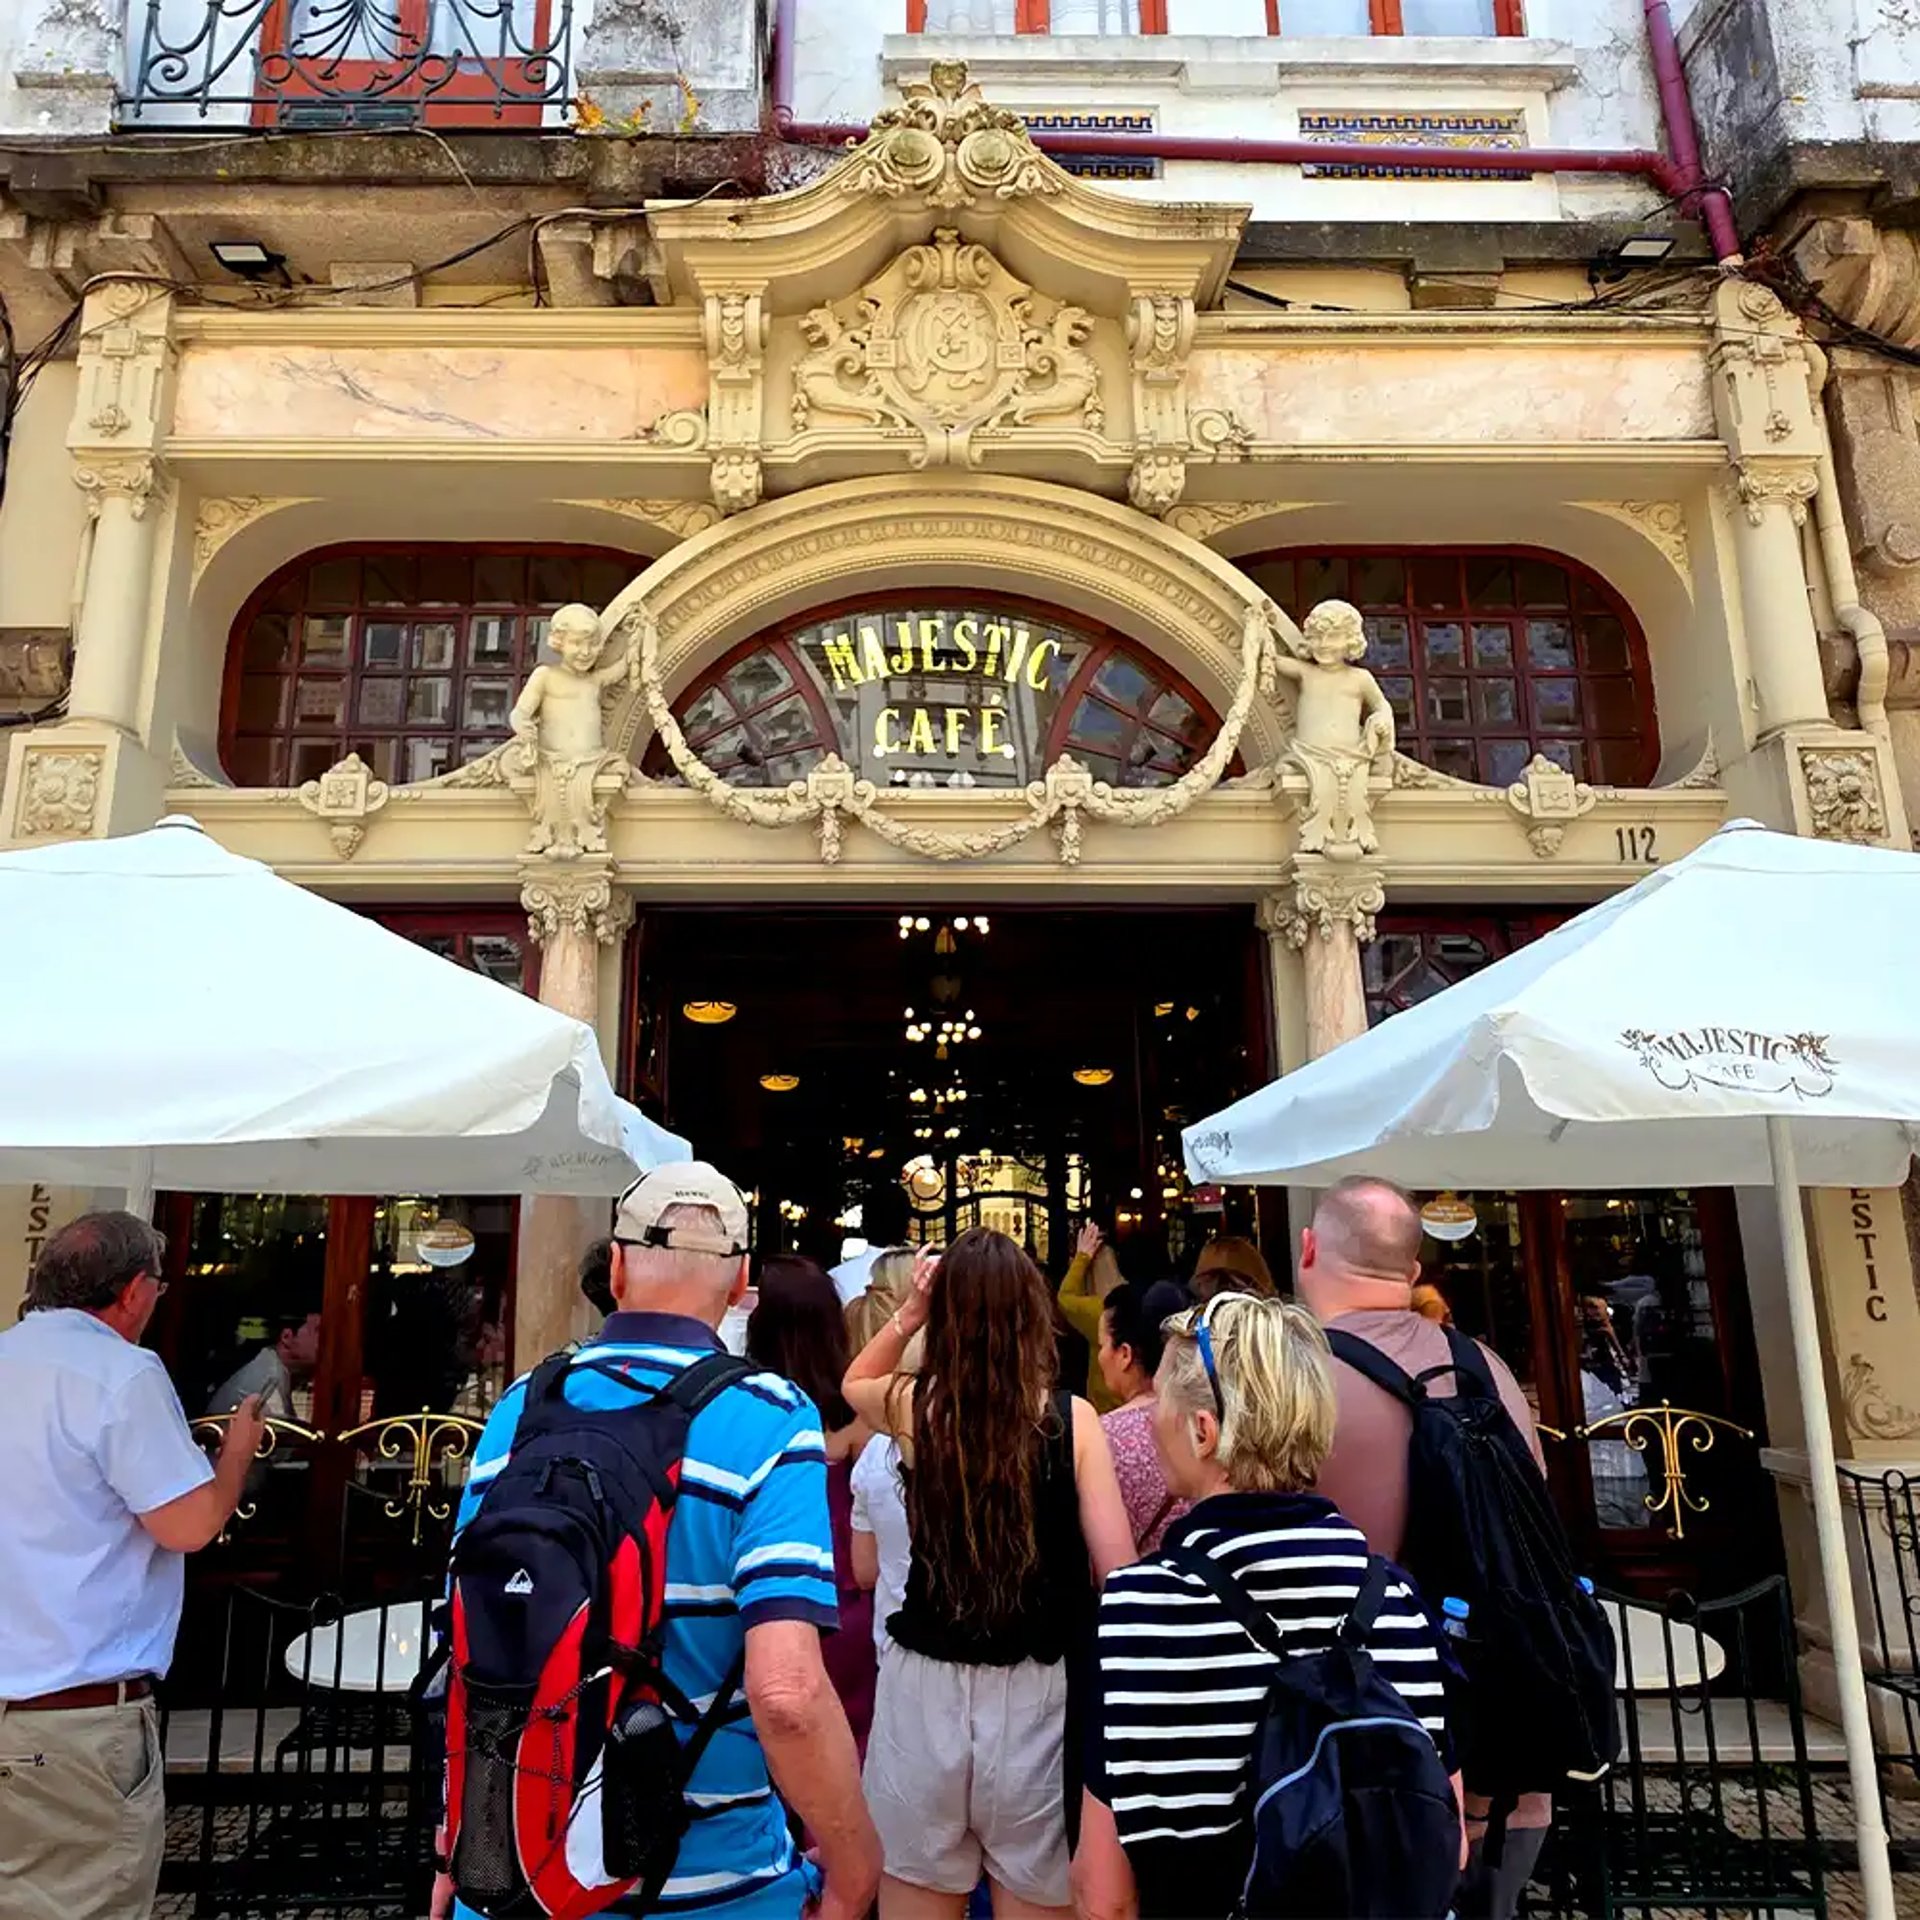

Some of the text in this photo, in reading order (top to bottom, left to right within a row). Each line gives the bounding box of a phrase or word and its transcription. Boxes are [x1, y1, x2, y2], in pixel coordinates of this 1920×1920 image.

[821, 619, 1061, 691] MAJESTIC
[1616, 826, 1659, 864] 112
[1656, 1028, 1788, 1065] MAJESTIC
